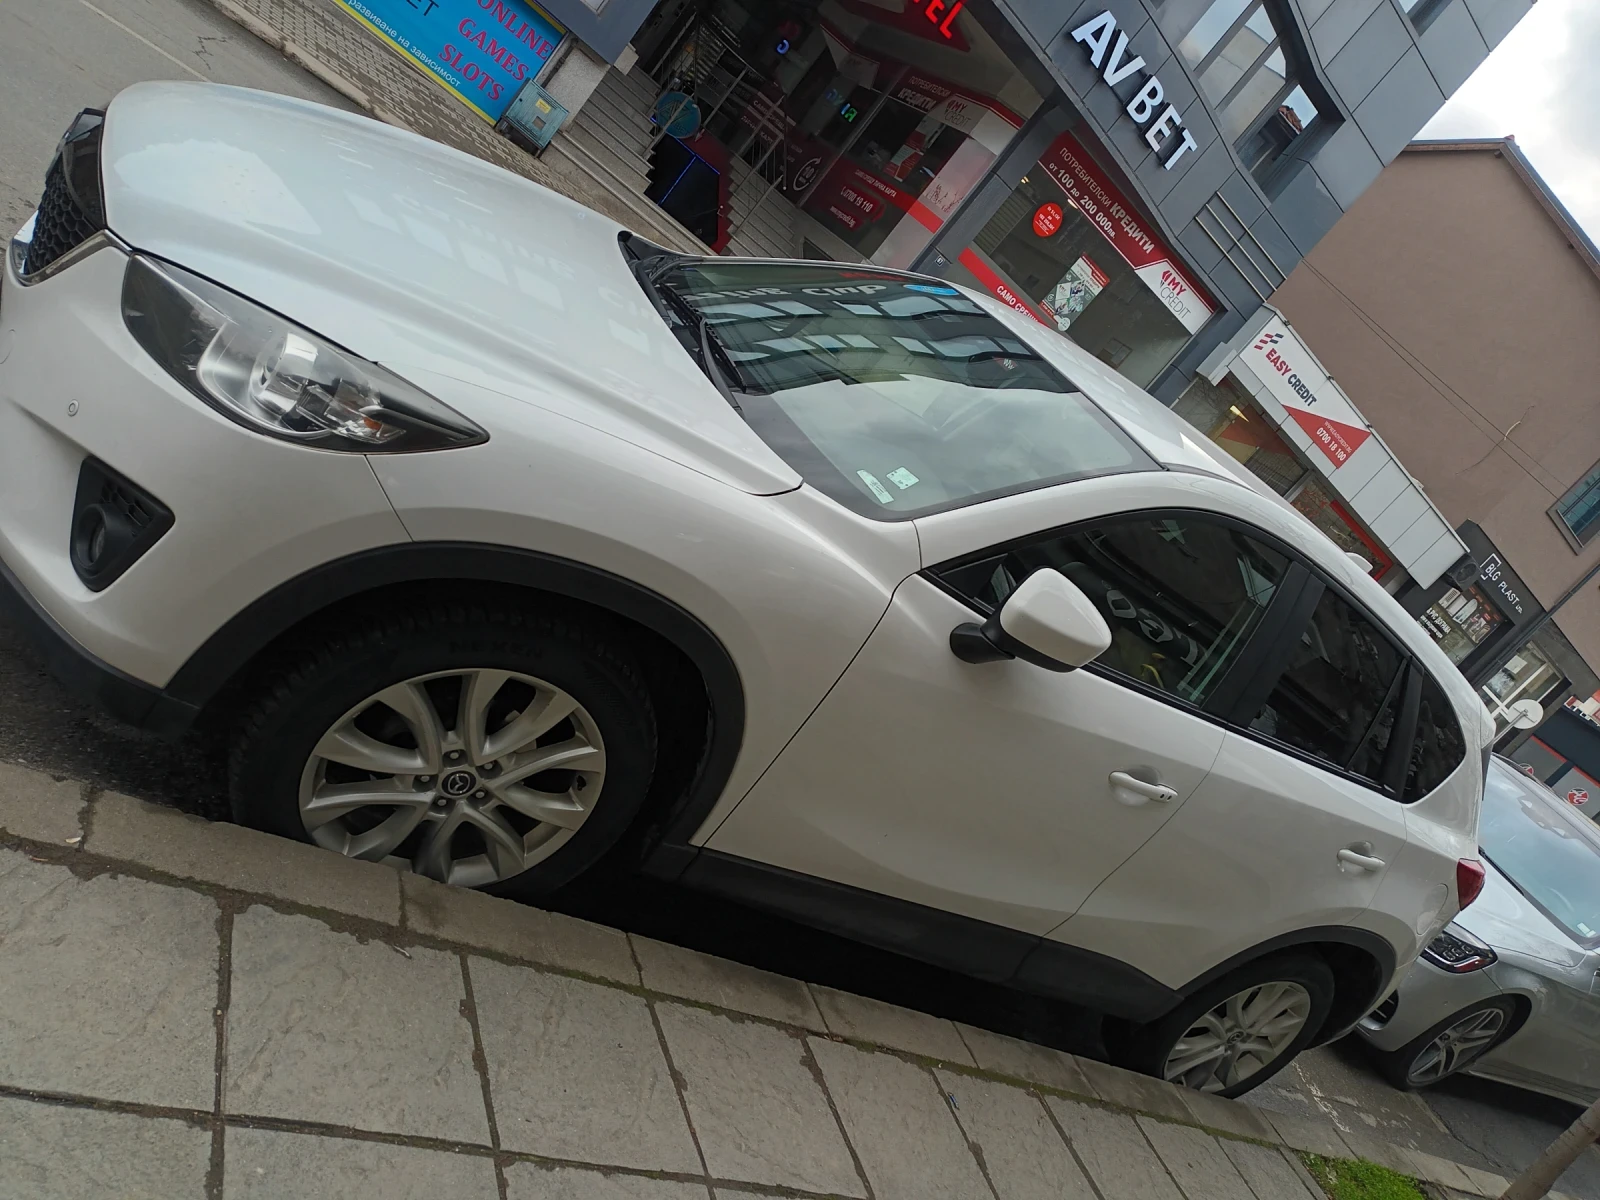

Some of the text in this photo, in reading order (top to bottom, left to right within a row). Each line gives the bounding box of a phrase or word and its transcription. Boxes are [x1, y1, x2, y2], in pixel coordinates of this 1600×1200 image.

[347, 0, 462, 88] развиване на зависимост
[458, 17, 530, 81] GAMES
[476, 0, 554, 60] ONLINE
[439, 43, 505, 101] SLOTS
[1071, 9, 1199, 172] AV BET
[1049, 162, 1058, 172] от
[1058, 168, 1074, 190] 100
[1070, 186, 1080, 198] до
[1079, 195, 1098, 214] 200
[1059, 147, 1112, 208] ПОТРЕБИТЕЛСКИ
[1109, 202, 1156, 254] КРЕДИТИ
[996, 285, 1016, 309] САМО
[1160, 285, 1192, 319] CREDIT
[1167, 275, 1186, 296] MY
[1265, 348, 1317, 407] EASY CREDIT
[1316, 427, 1347, 462] 0700 18 100
[1485, 563, 1502, 581] BLG
[1498, 581, 1520, 605] PLAST
[1434, 616, 1452, 635] ДОГРАМА
